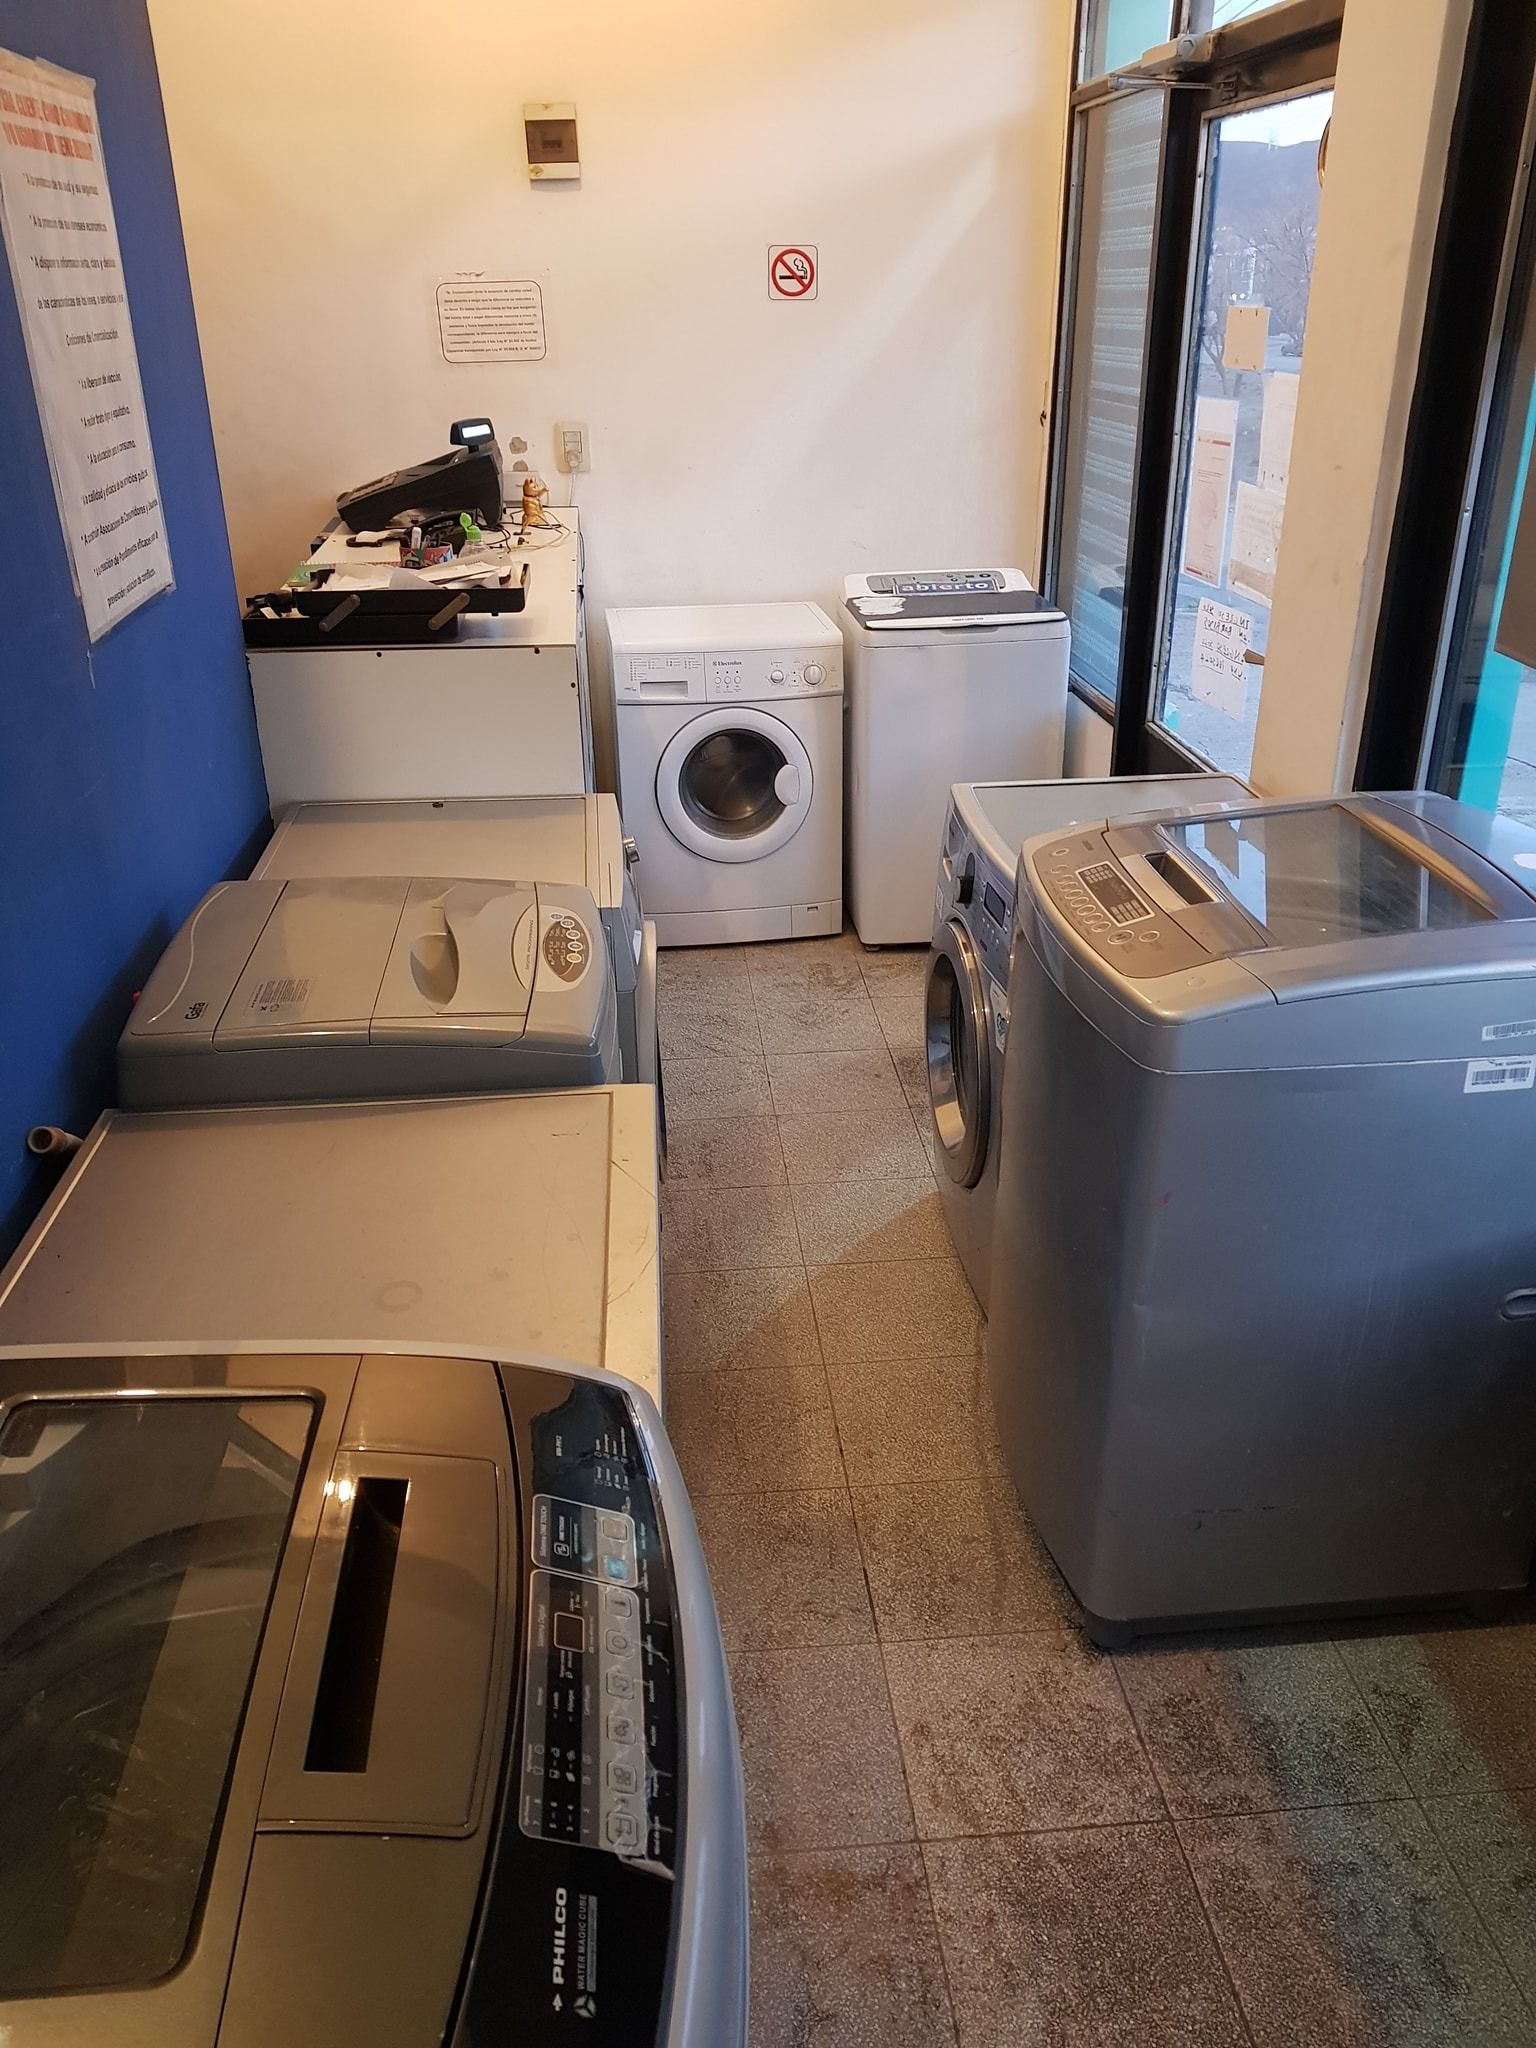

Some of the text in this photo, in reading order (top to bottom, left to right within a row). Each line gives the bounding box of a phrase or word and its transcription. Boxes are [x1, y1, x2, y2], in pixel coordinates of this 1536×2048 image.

[901, 580, 990, 593] abierto
[536, 1604, 546, 1623] Digital
[552, 1887, 568, 1985] PHILCO
[576, 1894, 588, 1990] WATER MAGIC CUBE
